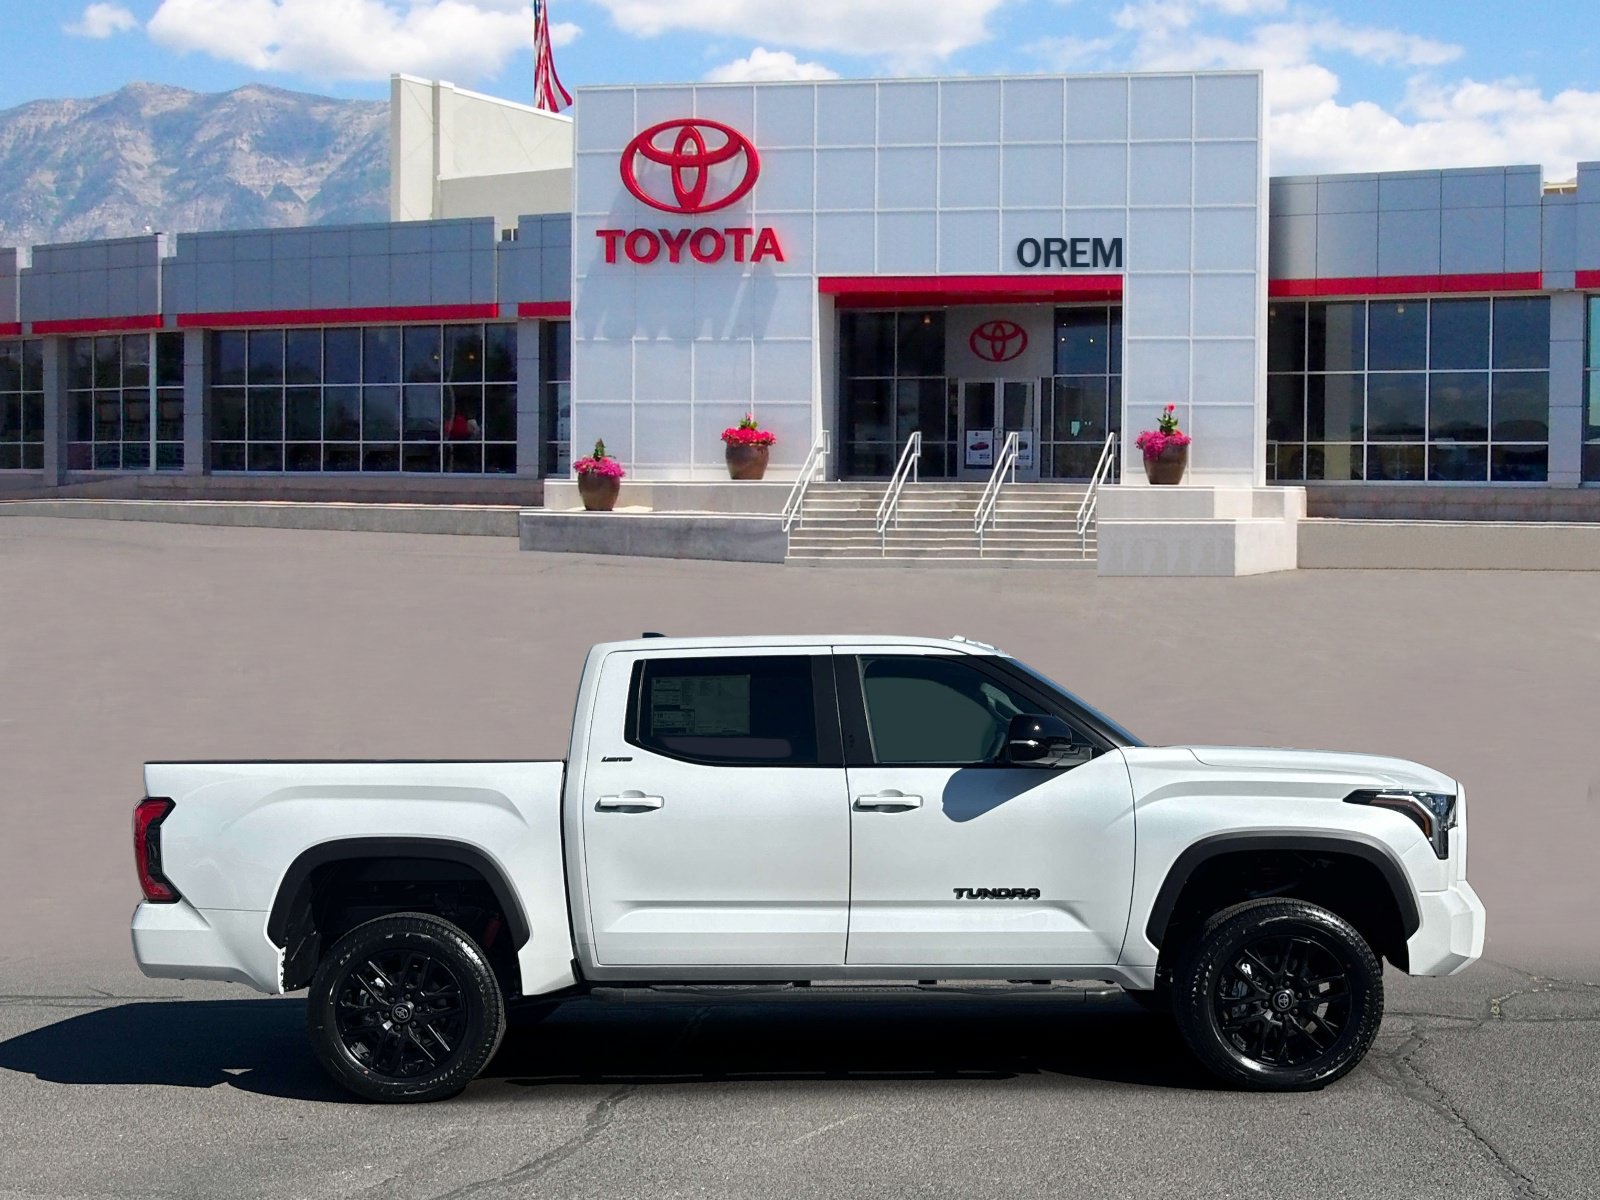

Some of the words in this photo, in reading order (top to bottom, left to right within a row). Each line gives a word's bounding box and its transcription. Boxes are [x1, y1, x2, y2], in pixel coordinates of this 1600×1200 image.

[596, 227, 785, 264] TOYOTA
[1017, 238, 1123, 267] OREM
[953, 887, 1041, 900] TUNDRA
